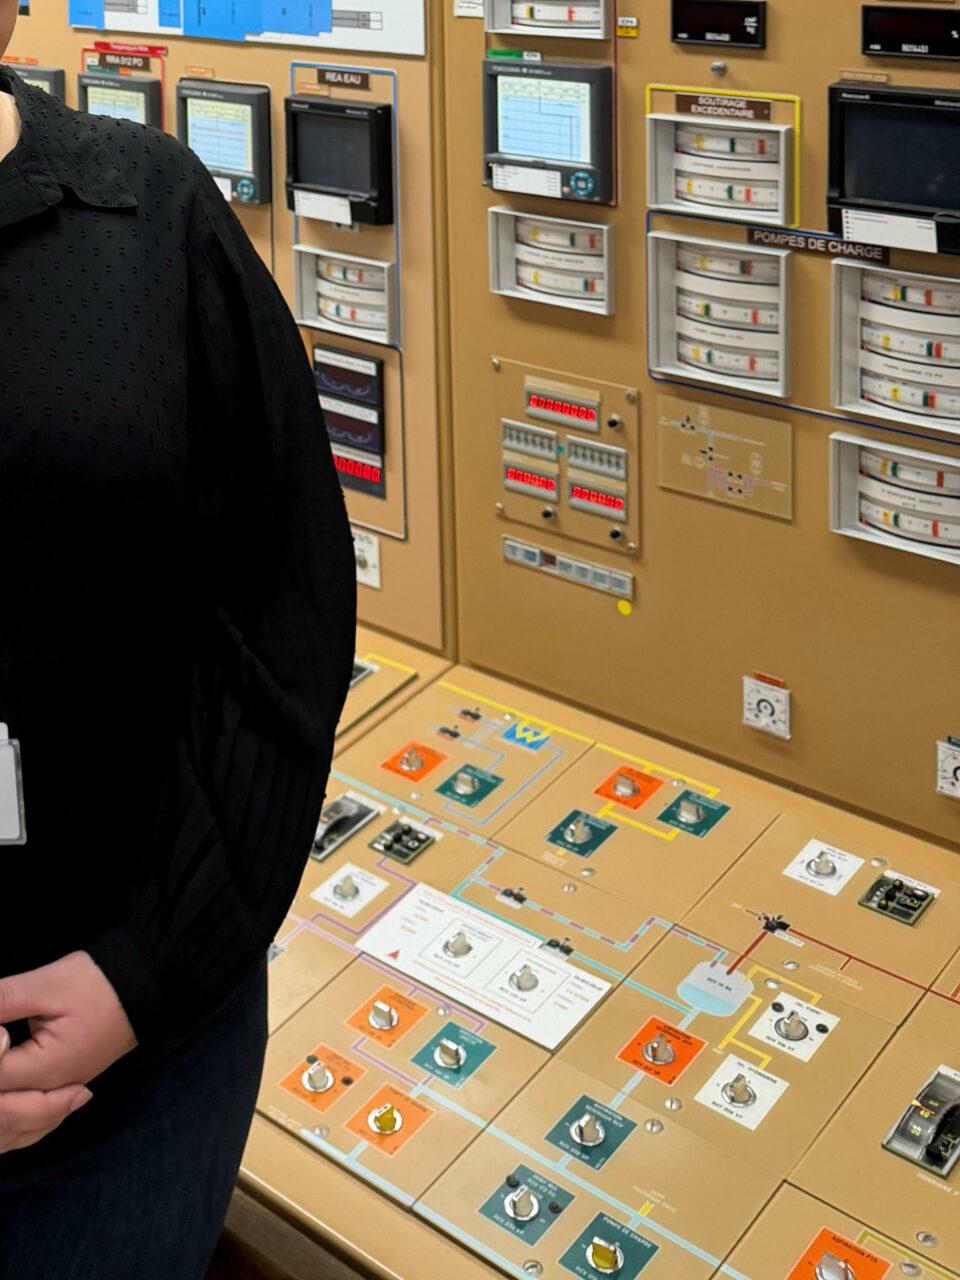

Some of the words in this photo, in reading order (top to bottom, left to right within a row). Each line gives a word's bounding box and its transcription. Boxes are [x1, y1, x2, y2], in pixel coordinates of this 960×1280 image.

[325, 71, 343, 83] REA
[698, 96, 747, 109] SOUTIRAGE
[691, 104, 754, 118] EXCEDENTAIRE
[754, 231, 805, 248] POMPES
[808, 238, 826, 251] DE
[828, 241, 883, 259] CHARGE
[920, 1109, 930, 1119] 40
[601, 1215, 622, 1230] POMPE
[620, 1227, 630, 1235] DE
[628, 1232, 652, 1248] CHARGE
[830, 1235, 866, 1257] ASPIRATION
